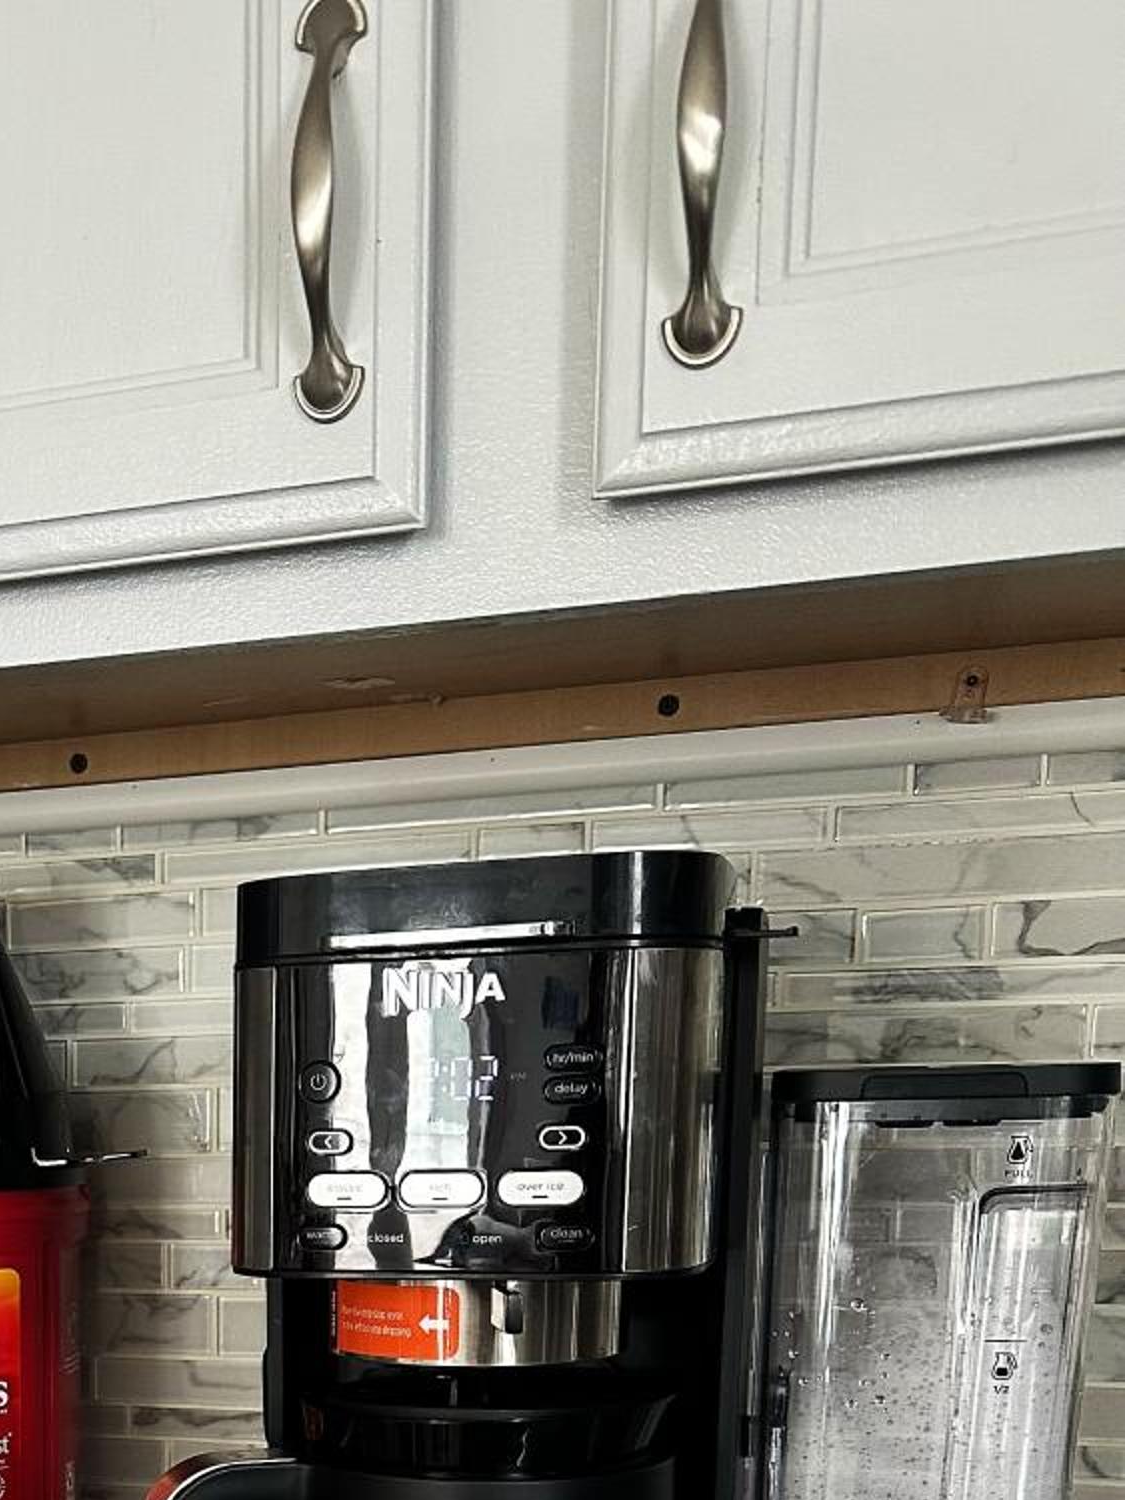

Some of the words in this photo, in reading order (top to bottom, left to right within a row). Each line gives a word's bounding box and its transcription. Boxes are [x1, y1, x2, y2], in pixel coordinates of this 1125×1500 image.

[382, 965, 506, 1019] NINJA
[554, 1082, 588, 1095] delay
[516, 1183, 542, 1192] over
[368, 1232, 404, 1244] closed
[472, 1233, 502, 1245] open
[550, 1228, 583, 1239] clean
